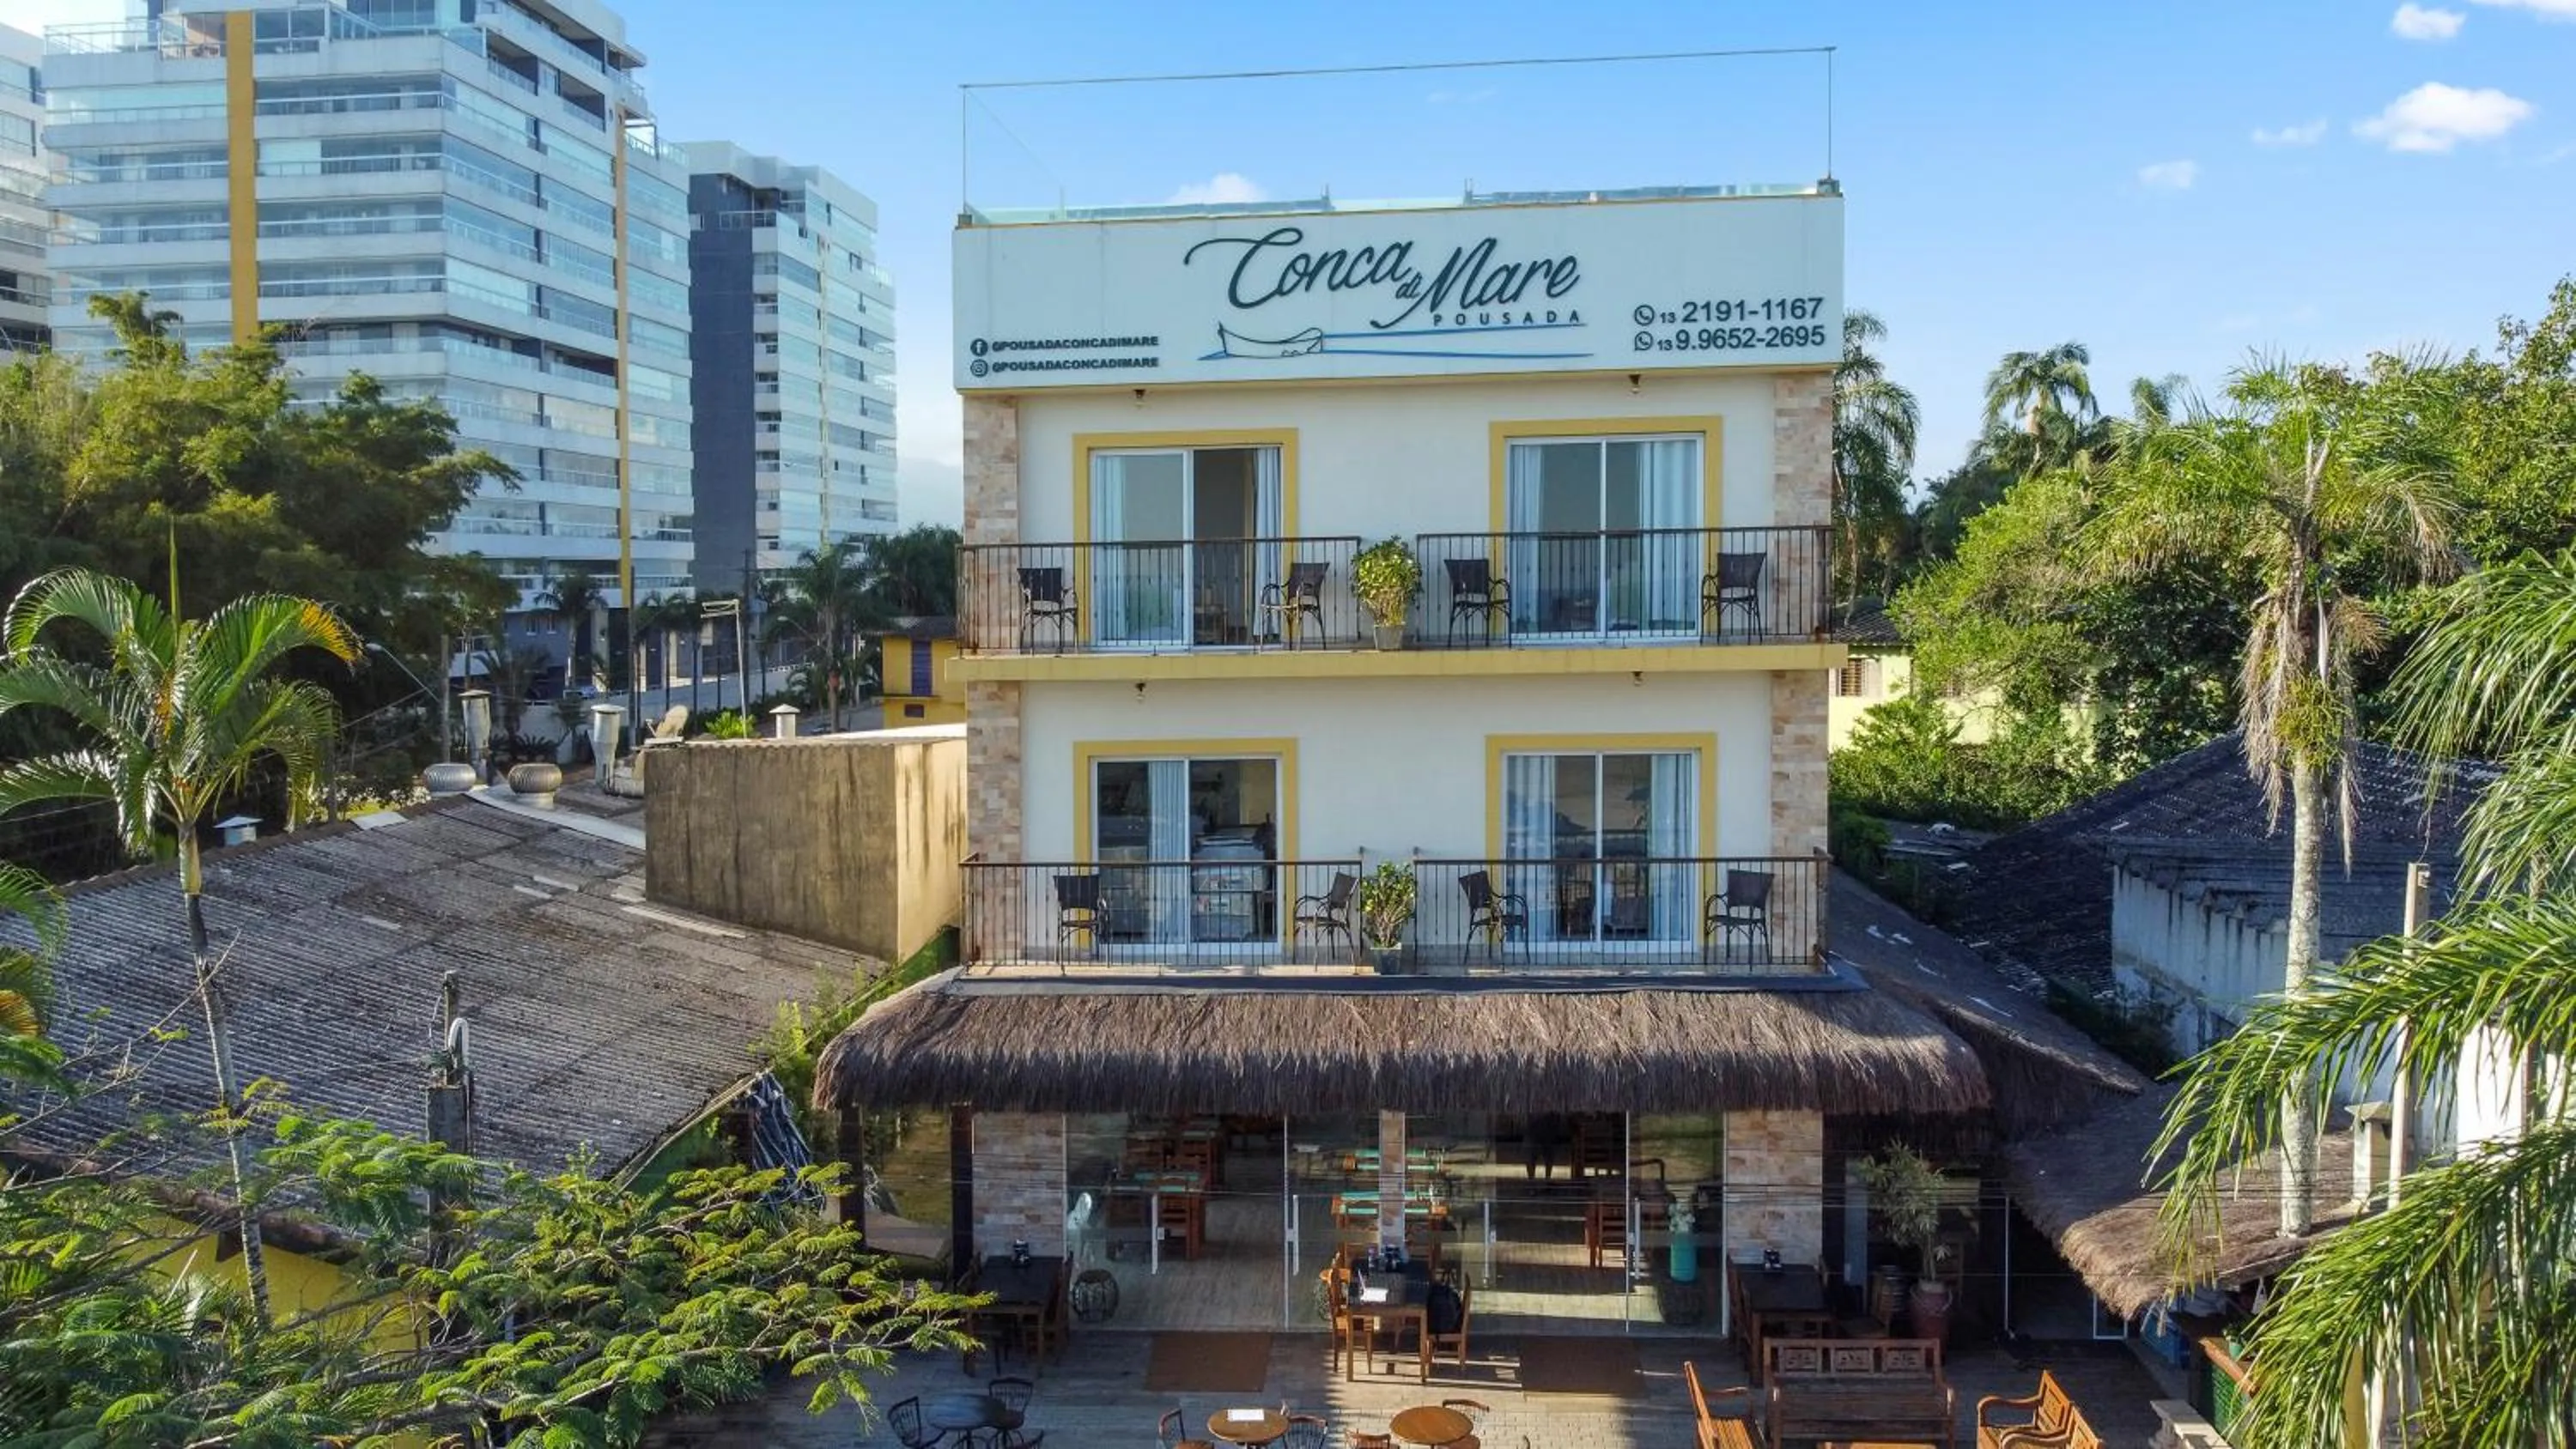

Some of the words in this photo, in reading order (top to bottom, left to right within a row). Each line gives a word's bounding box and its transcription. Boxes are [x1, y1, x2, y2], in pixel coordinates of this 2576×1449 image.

[1183, 227, 1413, 309] Conca
[1370, 237, 1581, 329] Mare
[1395, 270, 1423, 299] di
[1433, 309, 1580, 326] POUSADA
[1660, 312, 1676, 324] 13
[1681, 297, 1824, 323] 2191-1167
[992, 336, 1159, 352] @POUSADACONCADIMARE
[1657, 339, 1674, 351] 13
[1675, 324, 1826, 350] 9.9652-2695
[992, 356, 1159, 373] @POUSADACONCADIMARE
